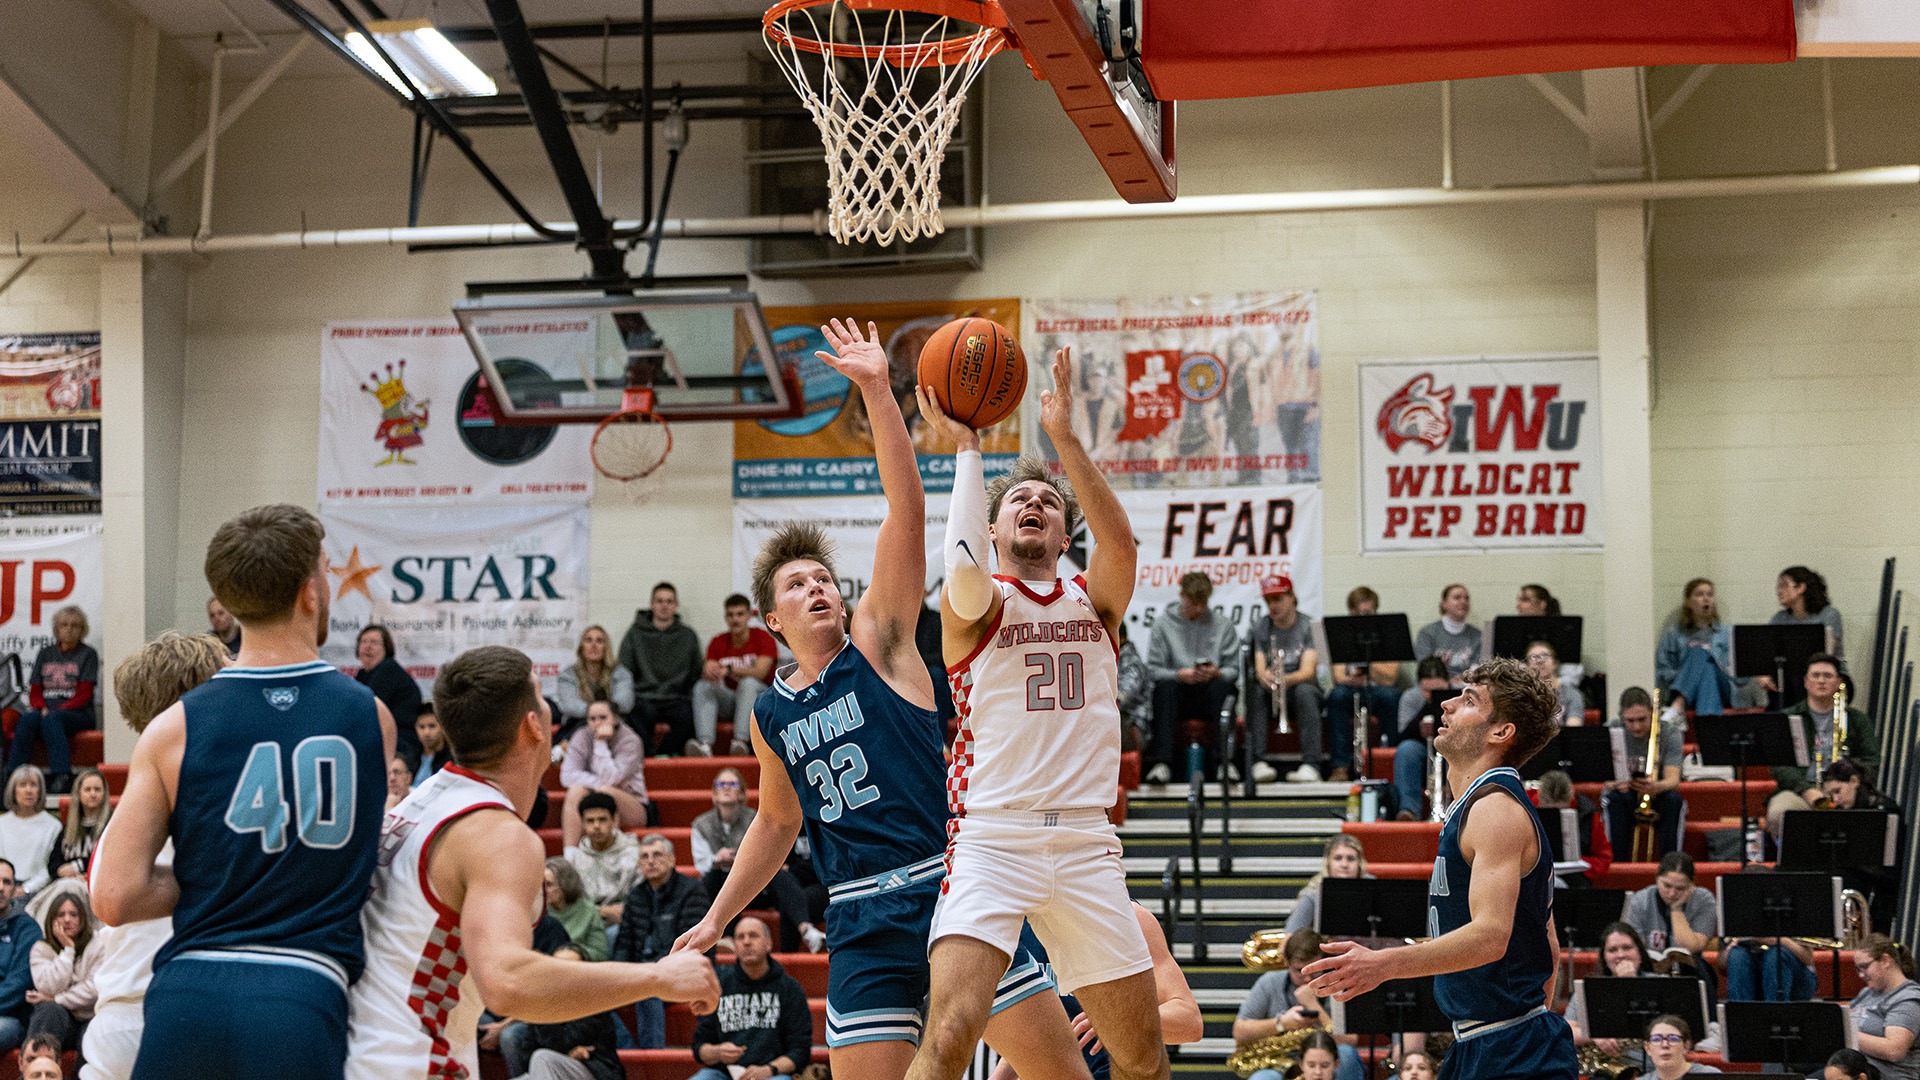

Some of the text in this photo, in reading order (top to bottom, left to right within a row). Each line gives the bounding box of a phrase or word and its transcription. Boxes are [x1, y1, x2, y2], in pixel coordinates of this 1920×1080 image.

[425, 323, 463, 336] INDIAN
[967, 333, 989, 396] LEGACY
[988, 333, 1016, 408] SPALDING
[1447, 384, 1586, 452] IWU
[738, 463, 805, 478] DINE-IN
[1386, 462, 1580, 499] WILDCAT
[1163, 498, 1294, 558] FEAR
[1383, 503, 1587, 539] PEP BAND
[392, 554, 564, 604] STAR
[997, 620, 1104, 649] WILDCATS
[1025, 652, 1086, 711] 20
[779, 692, 865, 765] MVNU
[224, 735, 357, 854] 40
[805, 743, 880, 823] 32
[719, 992, 780, 1011] INDIANA
